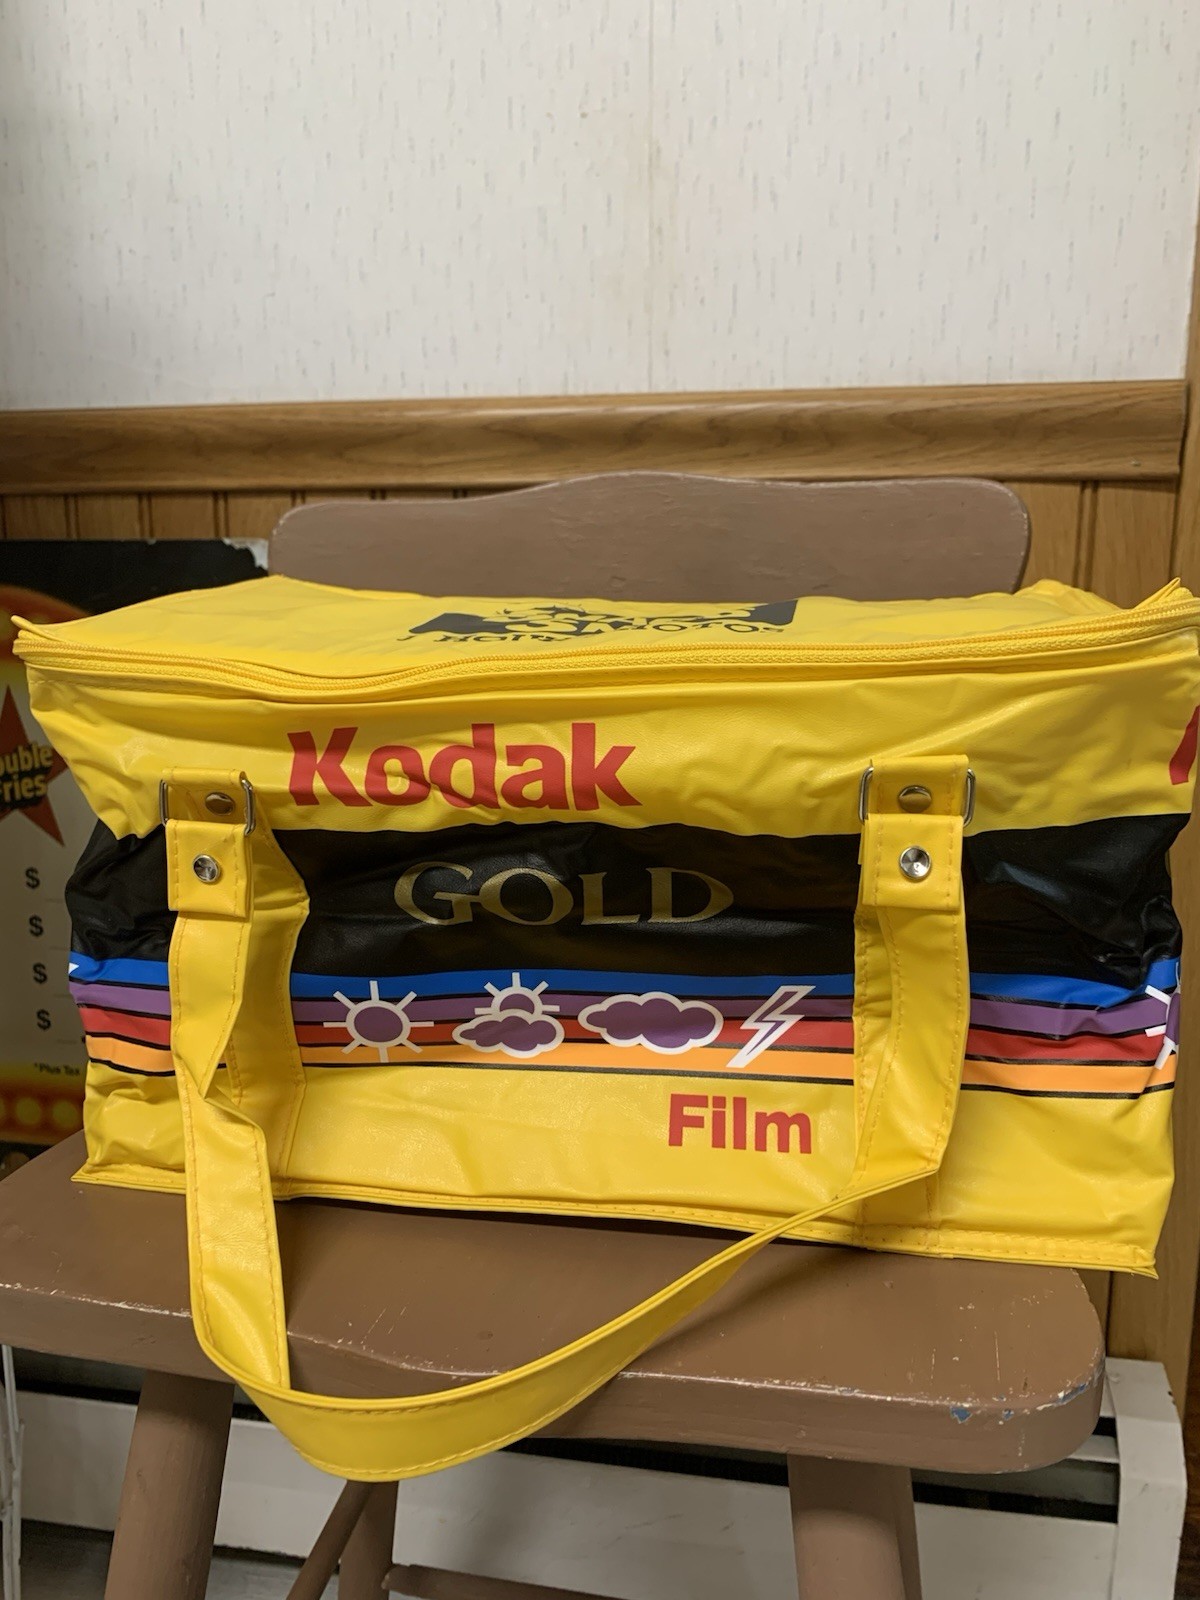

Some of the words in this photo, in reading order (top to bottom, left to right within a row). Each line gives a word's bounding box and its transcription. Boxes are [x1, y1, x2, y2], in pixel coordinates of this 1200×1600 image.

[287, 722, 643, 810] Kodak
[0, 774, 48, 803] ries
[25, 867, 40, 889] $
[394, 861, 734, 925] GOLD
[29, 915, 44, 937] $
[33, 962, 48, 984] $
[36, 1009, 51, 1031] $
[668, 1093, 813, 1155] Film
